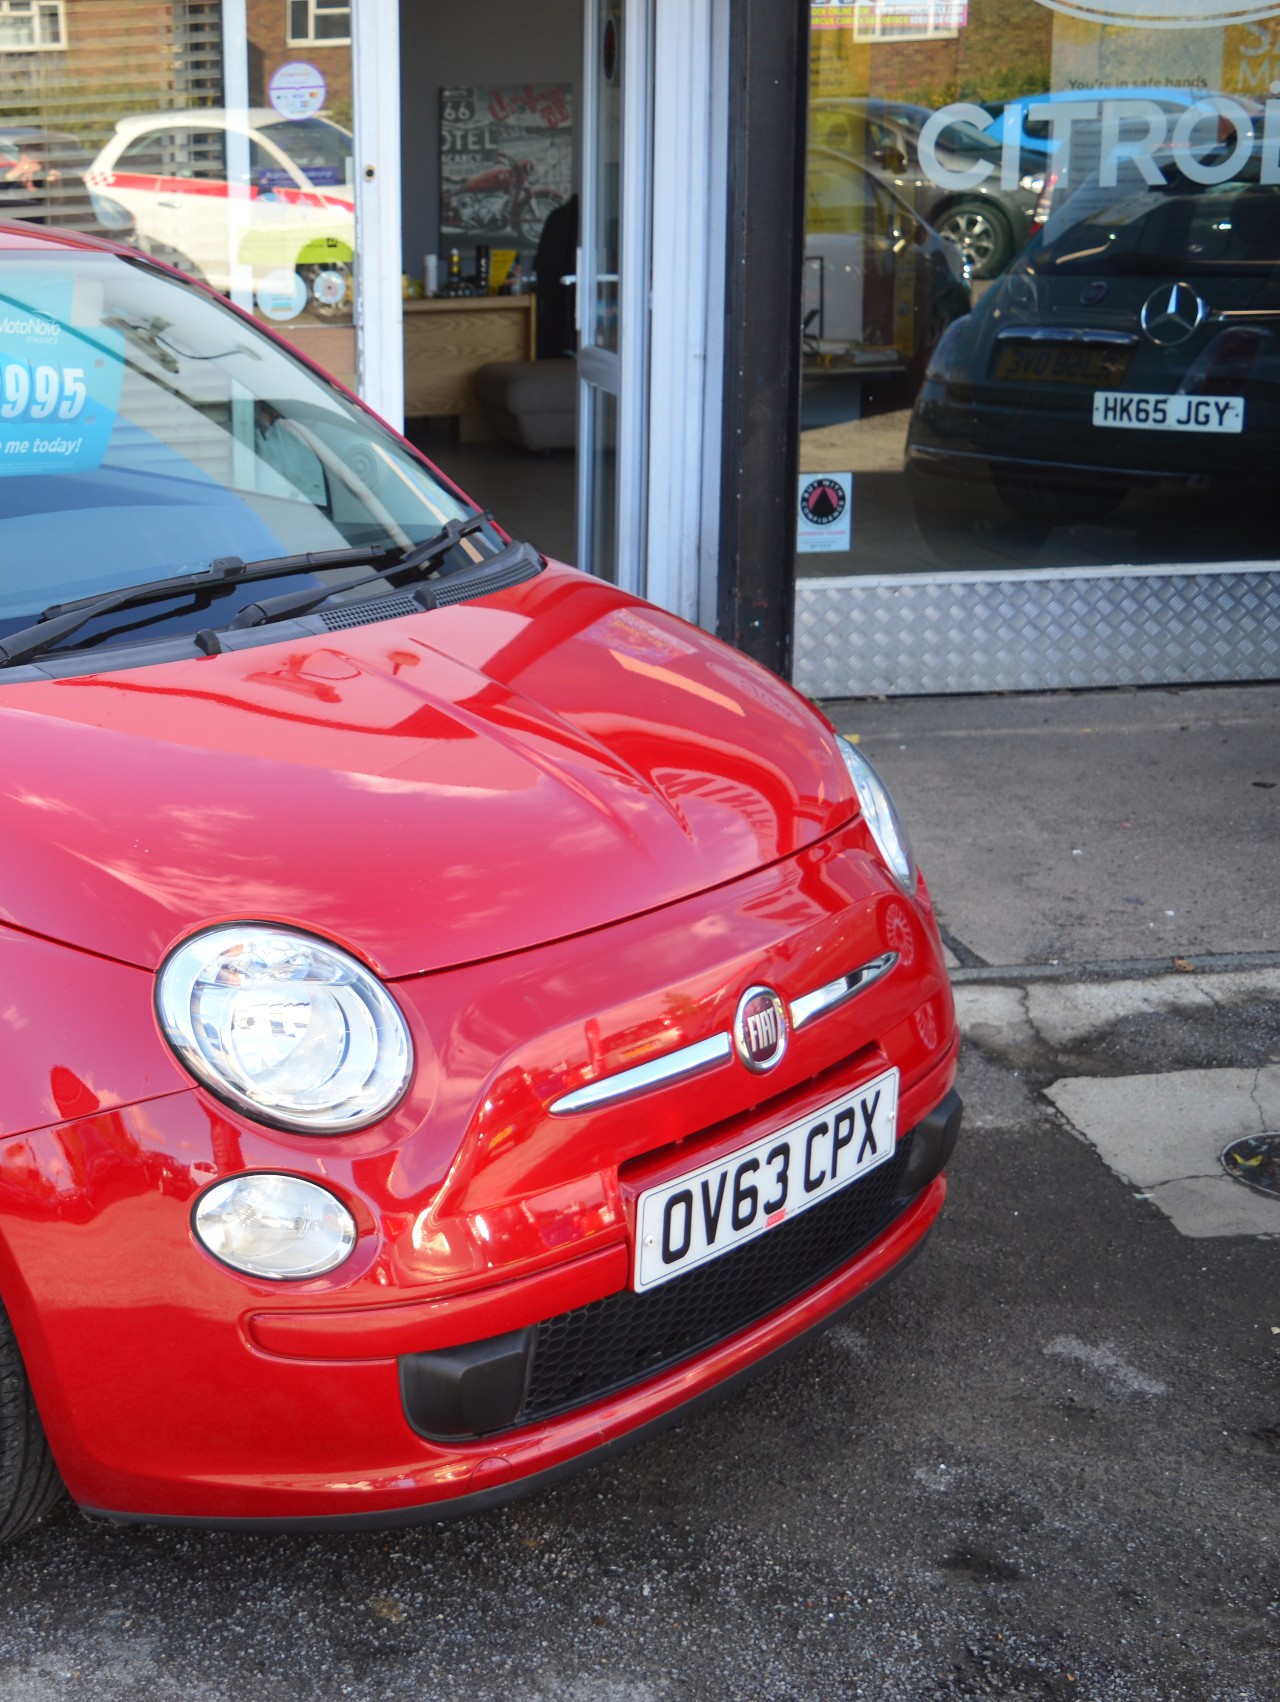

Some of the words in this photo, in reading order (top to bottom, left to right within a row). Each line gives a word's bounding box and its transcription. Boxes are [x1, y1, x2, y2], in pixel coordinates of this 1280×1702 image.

[1069, 78, 1111, 90] You're
[1116, 77, 1129, 88] in
[1132, 76, 1159, 88] safe
[1164, 75, 1208, 88] hands
[444, 102, 470, 120] 66
[27, 336, 59, 345] FINANCE
[1103, 396, 1169, 424] HK65
[1176, 400, 1231, 426] JGY
[4, 442, 29, 454] me
[32, 437, 83, 456] today!
[746, 1005, 778, 1053] FIAT
[661, 1141, 790, 1265] OV63
[803, 1088, 882, 1195] CPX
